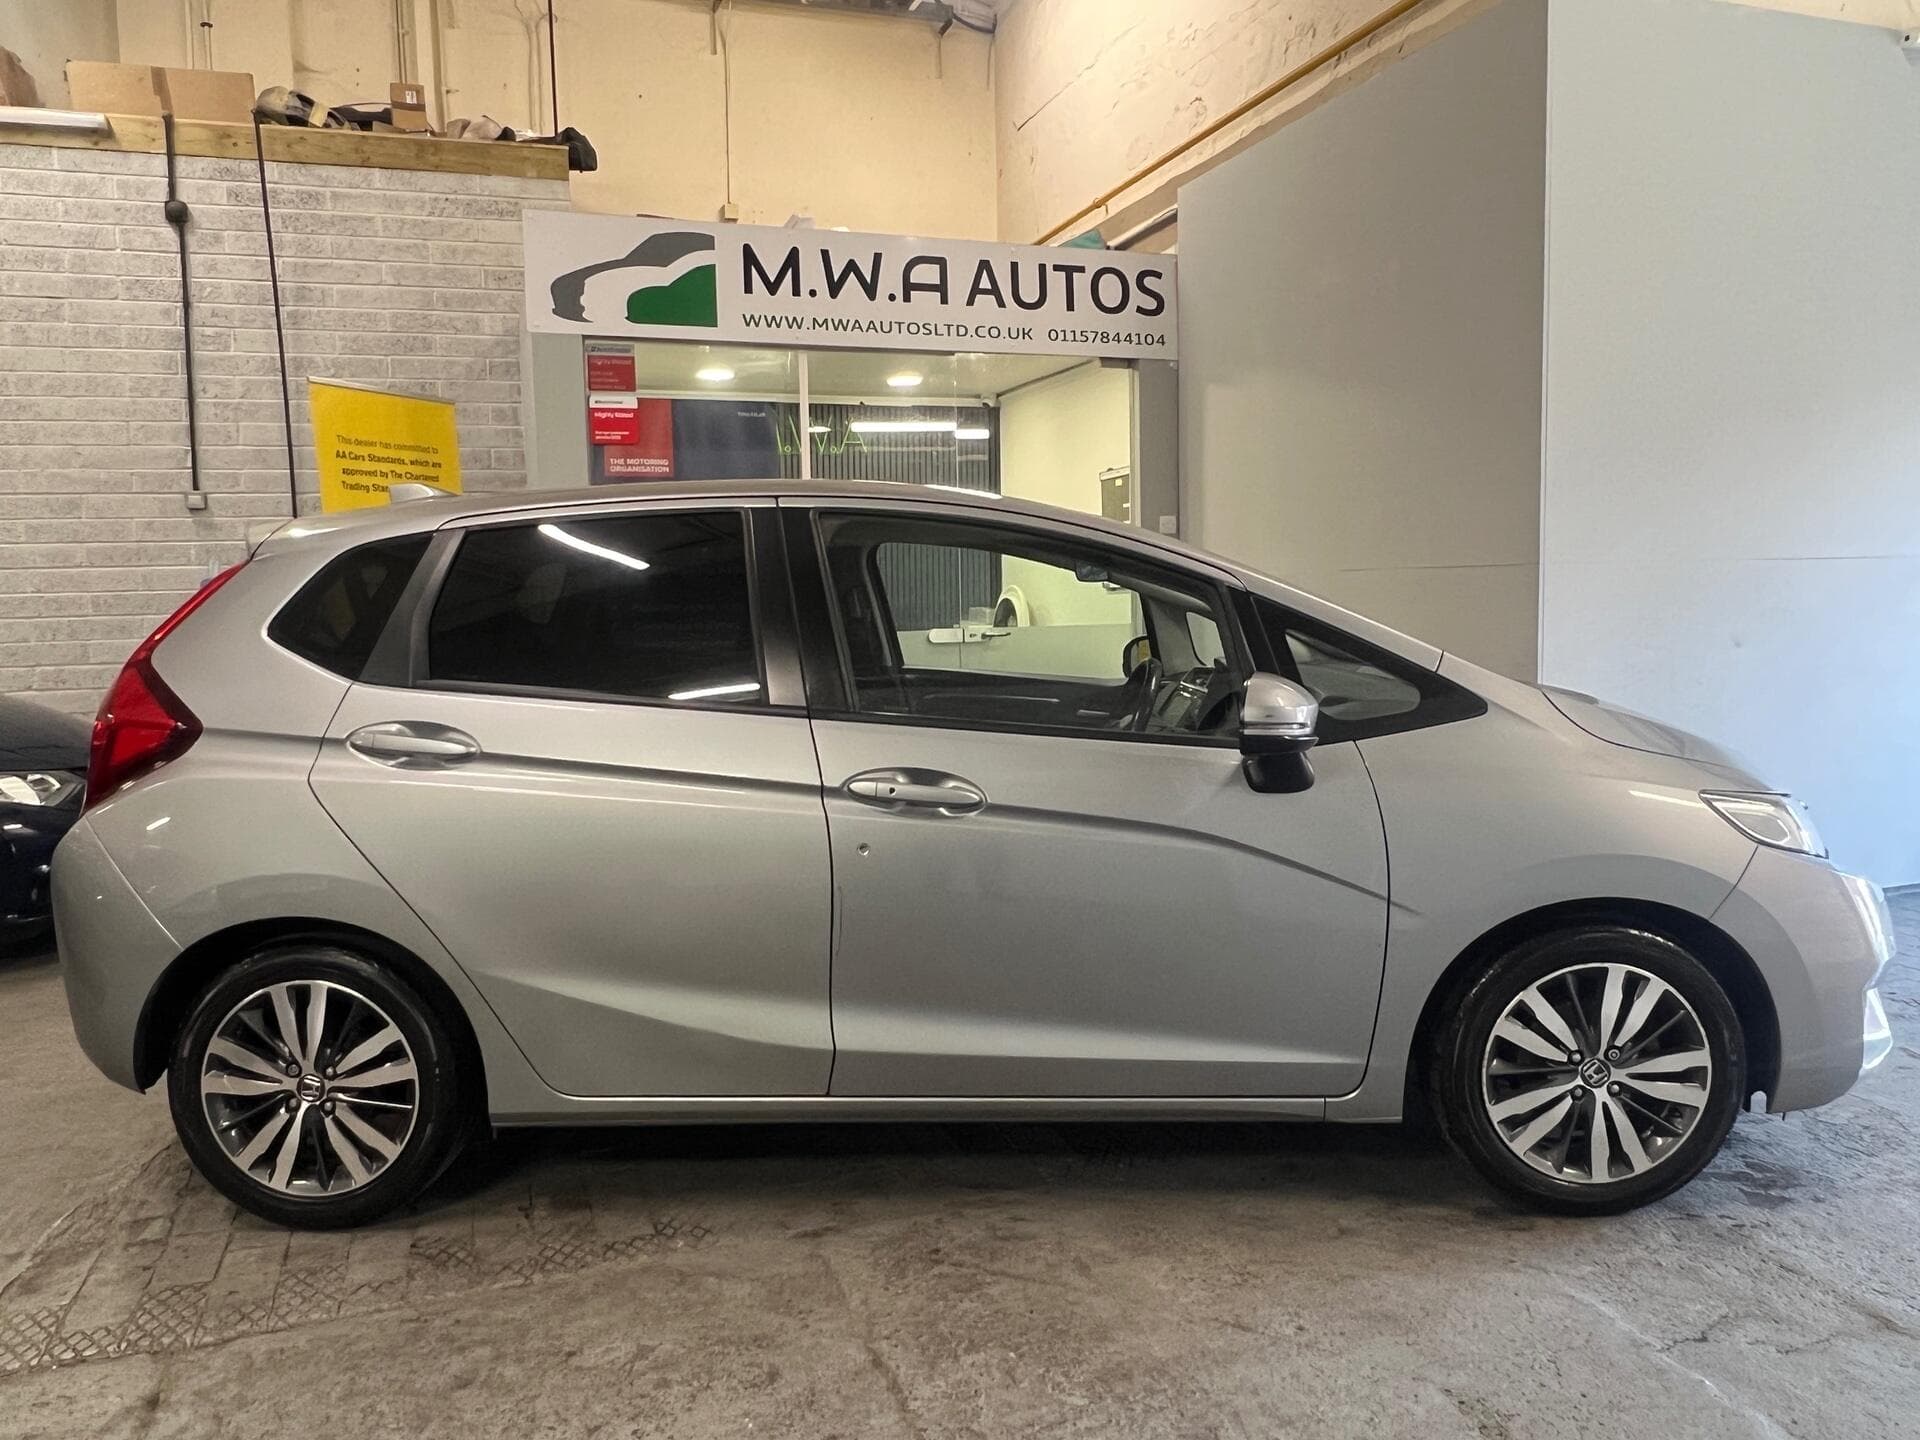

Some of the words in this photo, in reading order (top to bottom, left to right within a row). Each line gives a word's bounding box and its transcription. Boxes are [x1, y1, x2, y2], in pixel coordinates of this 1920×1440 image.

[742, 243, 949, 305] M.W.A
[965, 259, 1165, 317] AUTOS
[742, 313, 1033, 340] WWW.MWAAUTOSLTD.CO.UK
[1048, 329, 1166, 346] 01157844104
[336, 434, 352, 445] This
[354, 438, 378, 448] dealer
[379, 441, 392, 449] has
[393, 443, 430, 453] committed
[431, 446, 439, 454] to
[336, 449, 347, 459] AA
[348, 451, 365, 461] Cars
[409, 459, 430, 468] which
[626, 458, 669, 466] MOTORING
[342, 467, 378, 478] approved
[379, 469, 389, 479] by
[390, 470, 403, 480] The
[404, 471, 440, 482] Chartered
[610, 465, 670, 473] ORGANISATION
[341, 480, 370, 493] Trading
